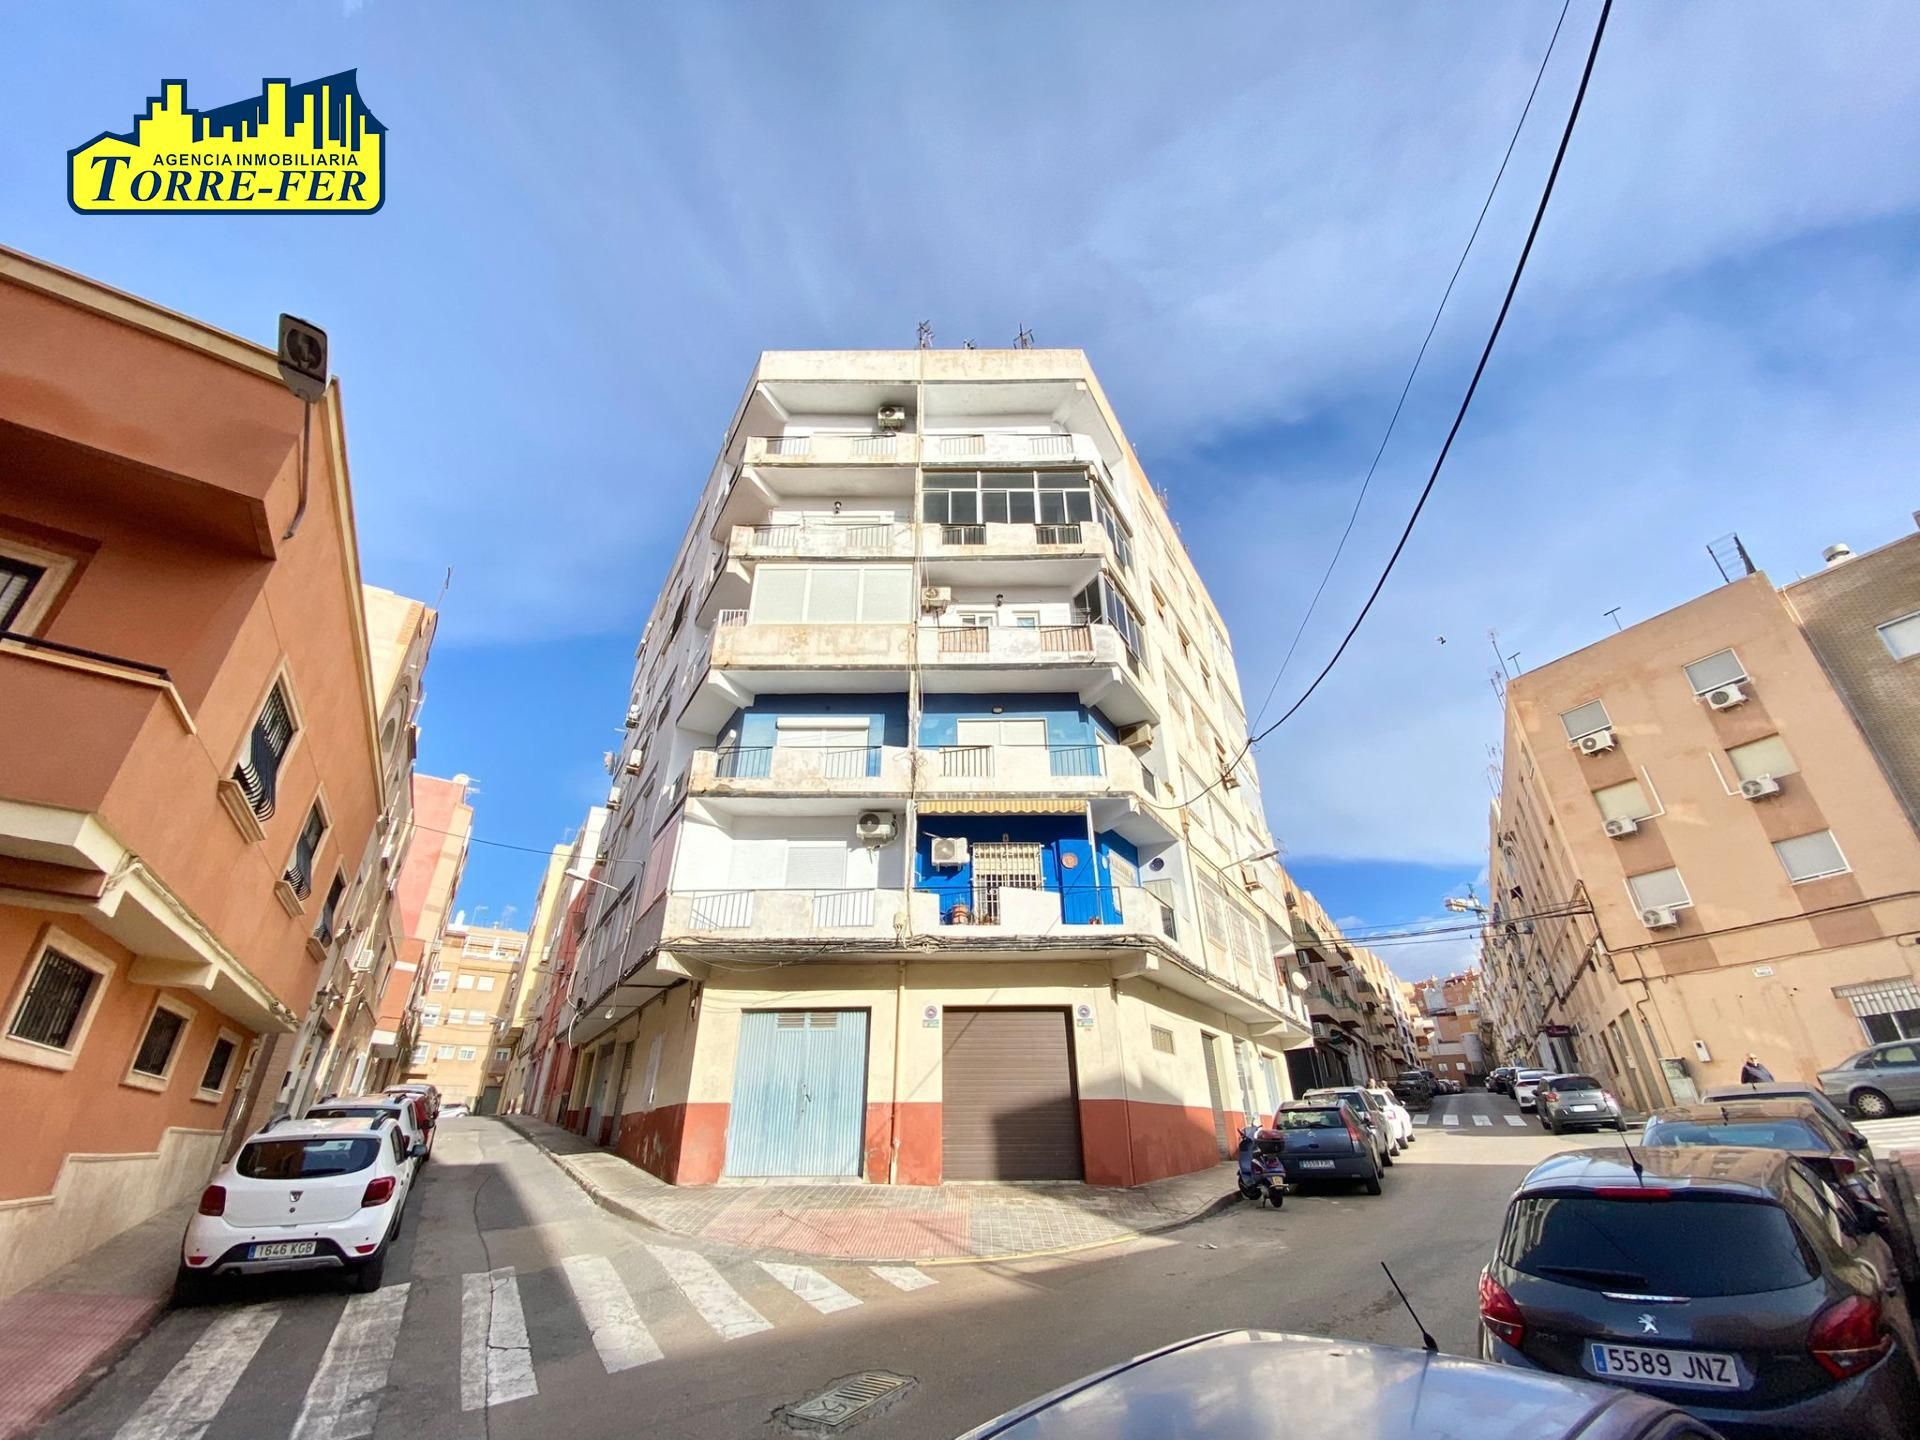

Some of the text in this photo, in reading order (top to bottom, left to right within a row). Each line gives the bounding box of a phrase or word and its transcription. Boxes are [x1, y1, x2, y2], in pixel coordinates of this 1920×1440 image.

[290, 1242, 314, 1254] KGB
[1608, 1348, 1732, 1383] 5589 JNZ
